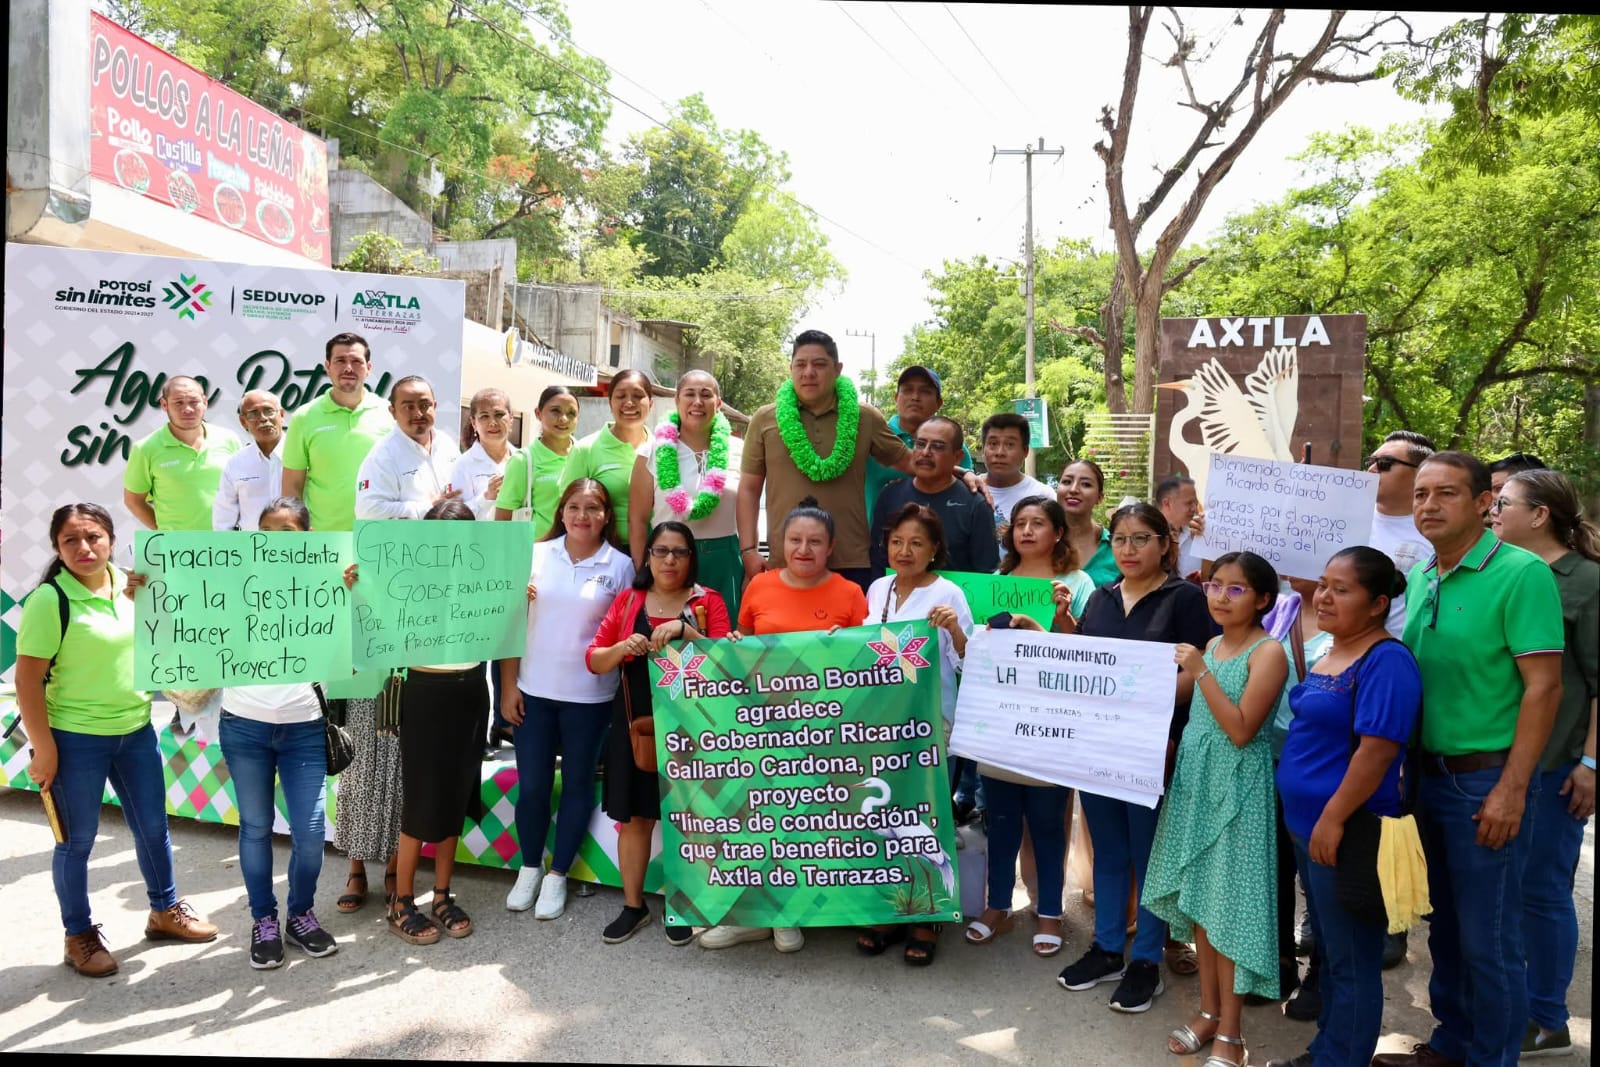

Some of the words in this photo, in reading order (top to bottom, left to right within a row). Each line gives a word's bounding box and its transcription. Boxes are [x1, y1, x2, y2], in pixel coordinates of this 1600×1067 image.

[93, 34, 190, 128] POLLOS
[195, 92, 212, 140] A
[216, 100, 241, 155] LA
[247, 116, 294, 181] LEÑA
[107, 106, 152, 145] Pollo
[55, 287, 85, 303] sin
[100, 280, 152, 292] POTOSÍ
[242, 289, 326, 306] SEDUVOP
[352, 290, 420, 310] AXTLA
[369, 310, 421, 319] TERRAZAS
[1187, 316, 1331, 348] AXTLA
[60, 422, 131, 466] sin
[1226, 472, 1269, 491] Ricardo
[1274, 478, 1327, 501] Gallardo
[1289, 464, 1371, 490] Gobernador
[1208, 493, 1255, 513] Gracias
[1261, 505, 1281, 519] por
[1286, 506, 1297, 523] el
[1301, 514, 1347, 531] apoyo
[1220, 511, 1255, 527] todas
[1262, 516, 1281, 532] las
[1286, 522, 1344, 544] familias
[144, 533, 242, 573] Gracias
[250, 532, 339, 565] Presidenta
[357, 521, 485, 575] GRACIAS
[1203, 535, 1230, 551] Vital
[1294, 540, 1316, 556] del
[148, 580, 190, 614] Por
[203, 580, 225, 610] la
[243, 575, 346, 612] Gestión
[387, 568, 514, 607] GOBERNADOR
[145, 619, 159, 645] Y
[173, 617, 230, 645] Hacer
[245, 613, 335, 643] Realidad
[356, 604, 386, 635] POR
[397, 607, 438, 632] HACER
[450, 603, 505, 620] REALIDAD
[366, 637, 395, 658] ESTE
[1014, 643, 1117, 666] FRACCIONAMIENTO
[151, 653, 199, 684] Este
[216, 647, 307, 680] Proyecto
[997, 665, 1017, 685] LA
[1038, 670, 1117, 696] REALIDAD
[683, 677, 750, 698] Fracc.
[756, 673, 819, 693] Loma
[824, 664, 903, 689] Bonita
[736, 699, 843, 726] agradece
[665, 732, 695, 752] Sr.
[699, 727, 834, 752] Gobernador
[840, 719, 932, 744] Ricardo
[1015, 722, 1076, 740] PRESENTE
[665, 758, 755, 780] Gallardo
[760, 754, 865, 776] Cardona,
[871, 750, 911, 776] por
[917, 746, 939, 767] el
[749, 783, 850, 809] proyecto
[747, 811, 776, 832] de
[679, 842, 717, 862] que
[722, 840, 766, 860] trae
[772, 837, 878, 860] beneficio
[885, 834, 939, 860] para
[708, 865, 763, 887] Axtla
[769, 864, 796, 886] de
[802, 864, 911, 887] Terrazas.
